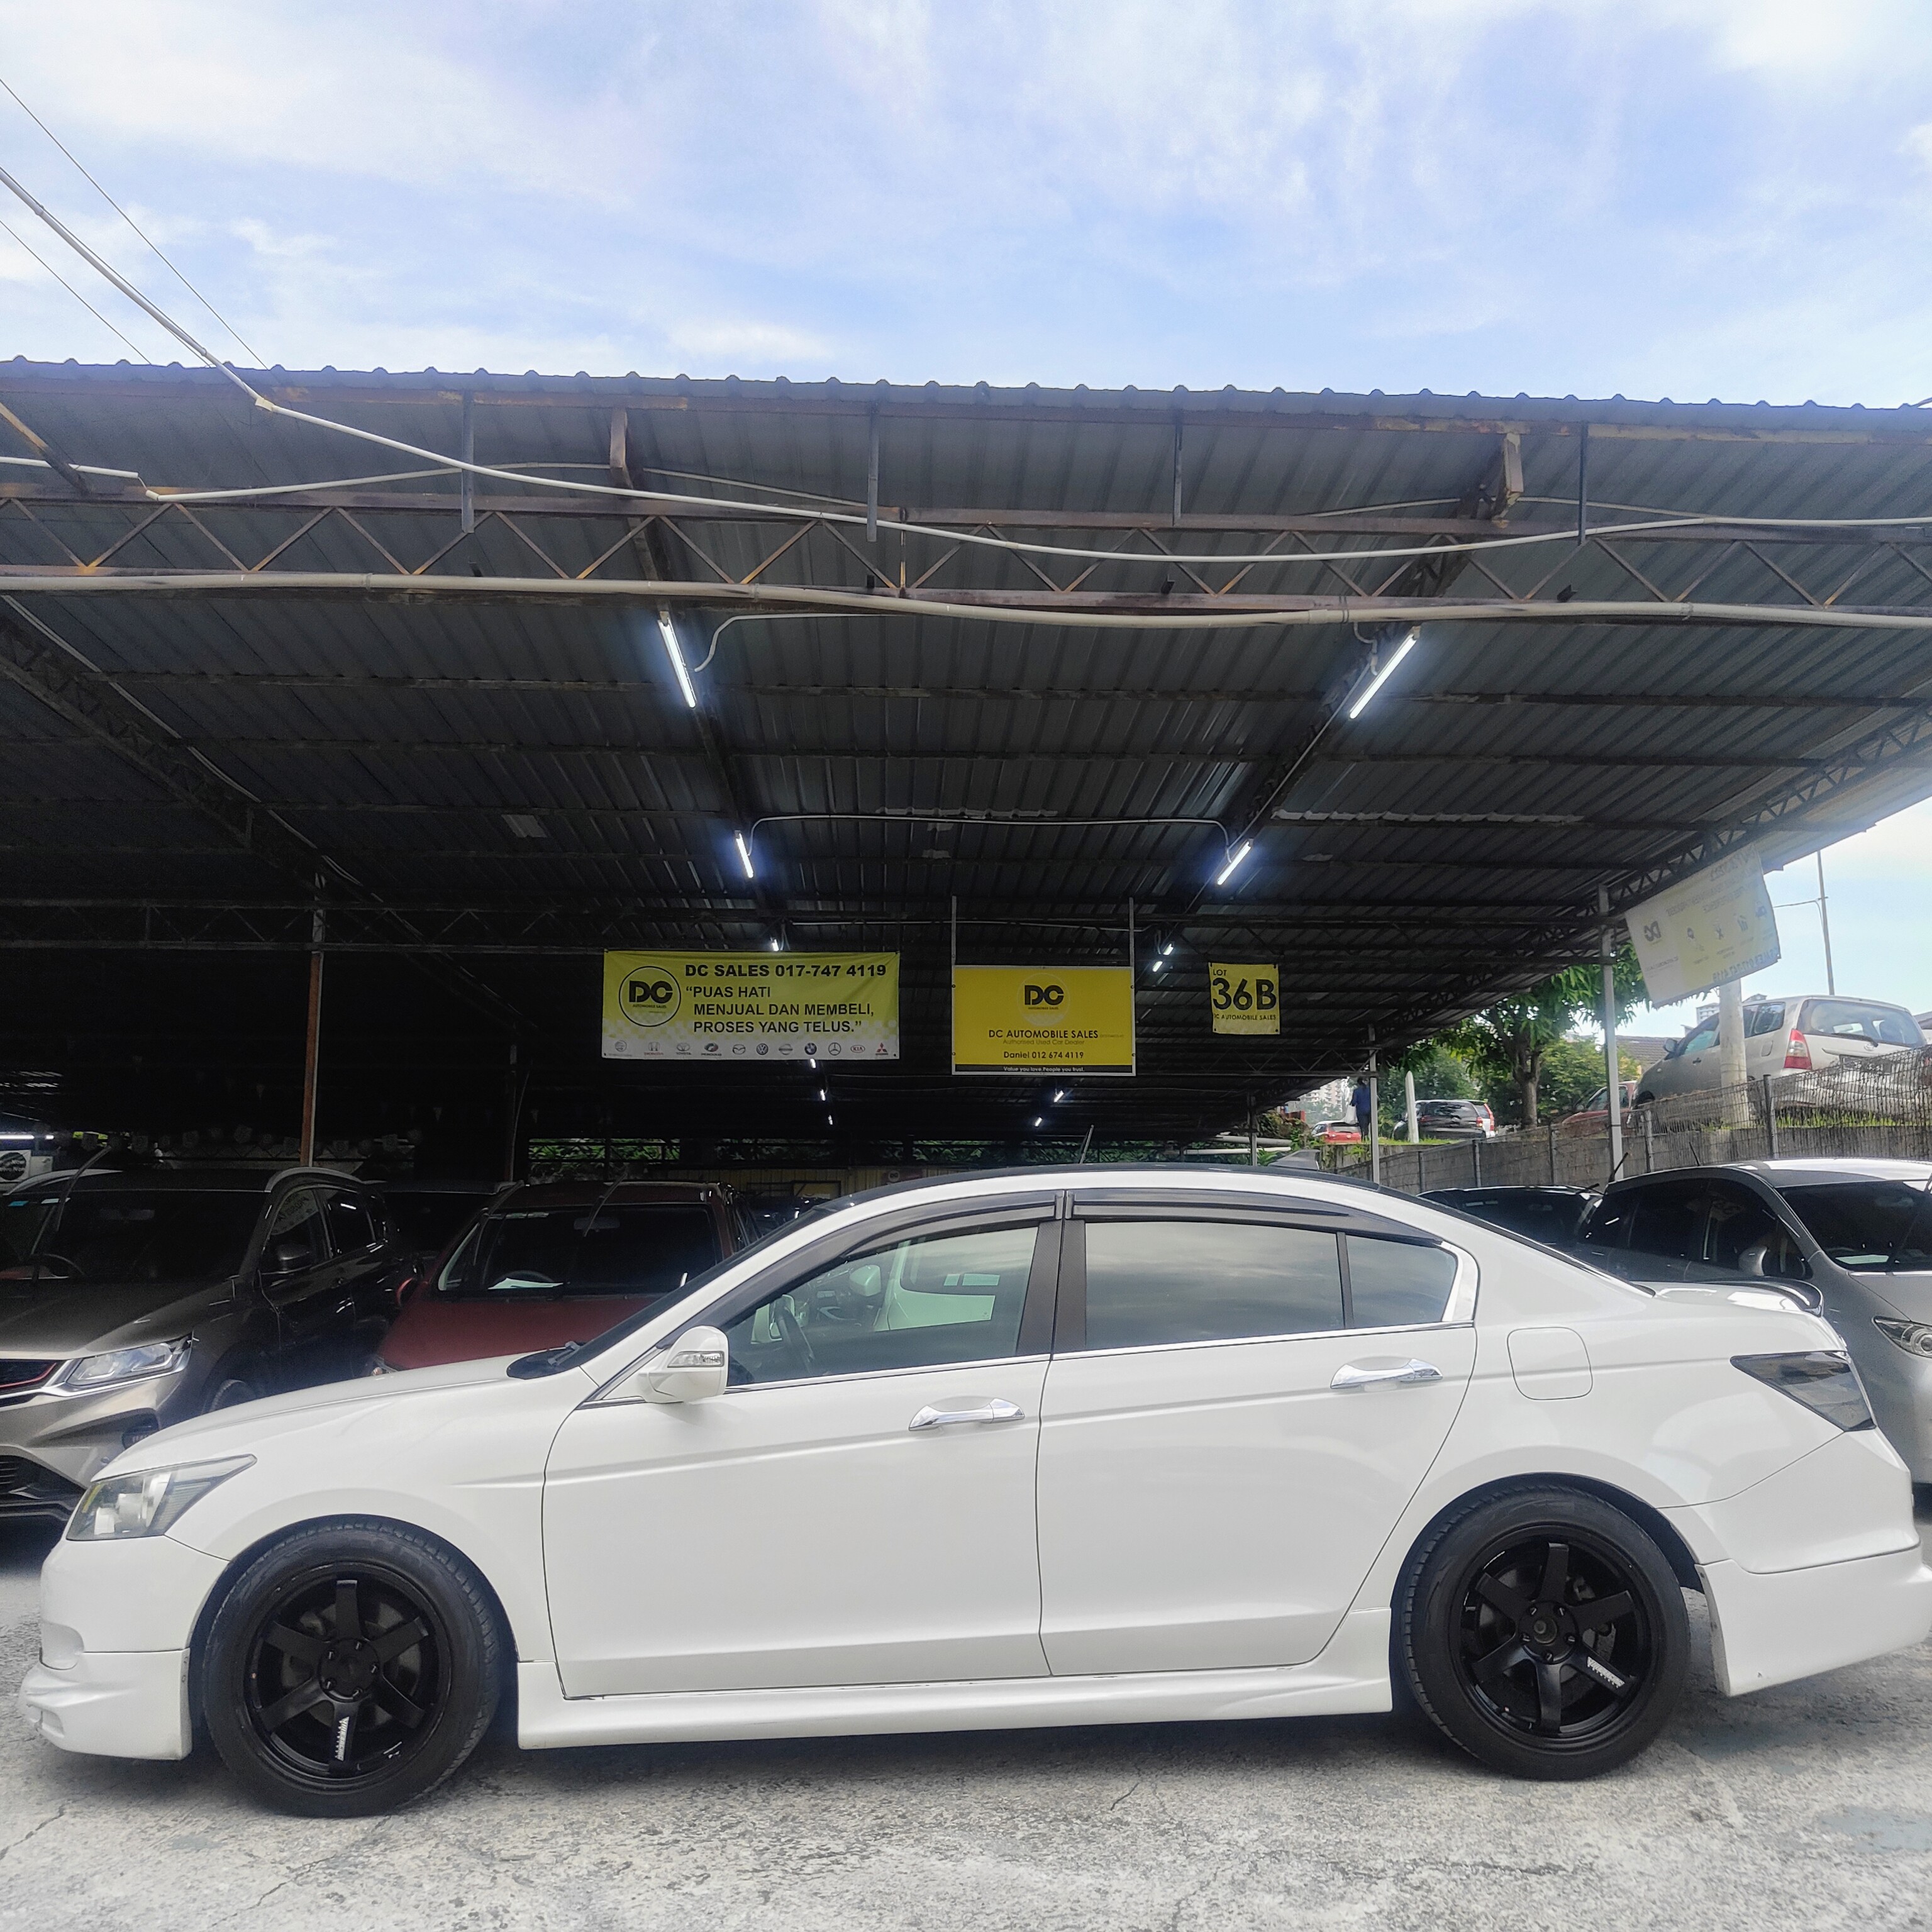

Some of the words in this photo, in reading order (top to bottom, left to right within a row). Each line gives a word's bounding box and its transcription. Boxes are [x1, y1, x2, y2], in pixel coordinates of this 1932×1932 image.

[685, 964, 708, 977] DC
[714, 964, 770, 977] SALES
[775, 964, 841, 977] 017-747
[846, 964, 886, 977] 4119
[629, 980, 673, 1004] DC
[738, 986, 770, 997] HATI
[1024, 984, 1064, 1006] DC
[1213, 977, 1277, 1011] 36B
[694, 1004, 764, 1015] MENJUAL
[769, 1004, 799, 1015] DAN
[804, 1003, 874, 1017] MEMBELI,
[694, 1021, 754, 1033] PROSES
[758, 1021, 799, 1033] YANG
[989, 1030, 1003, 1038] DC
[1006, 1030, 1068, 1038] AUTOMOBILE
[1071, 1030, 1098, 1038] SALES
